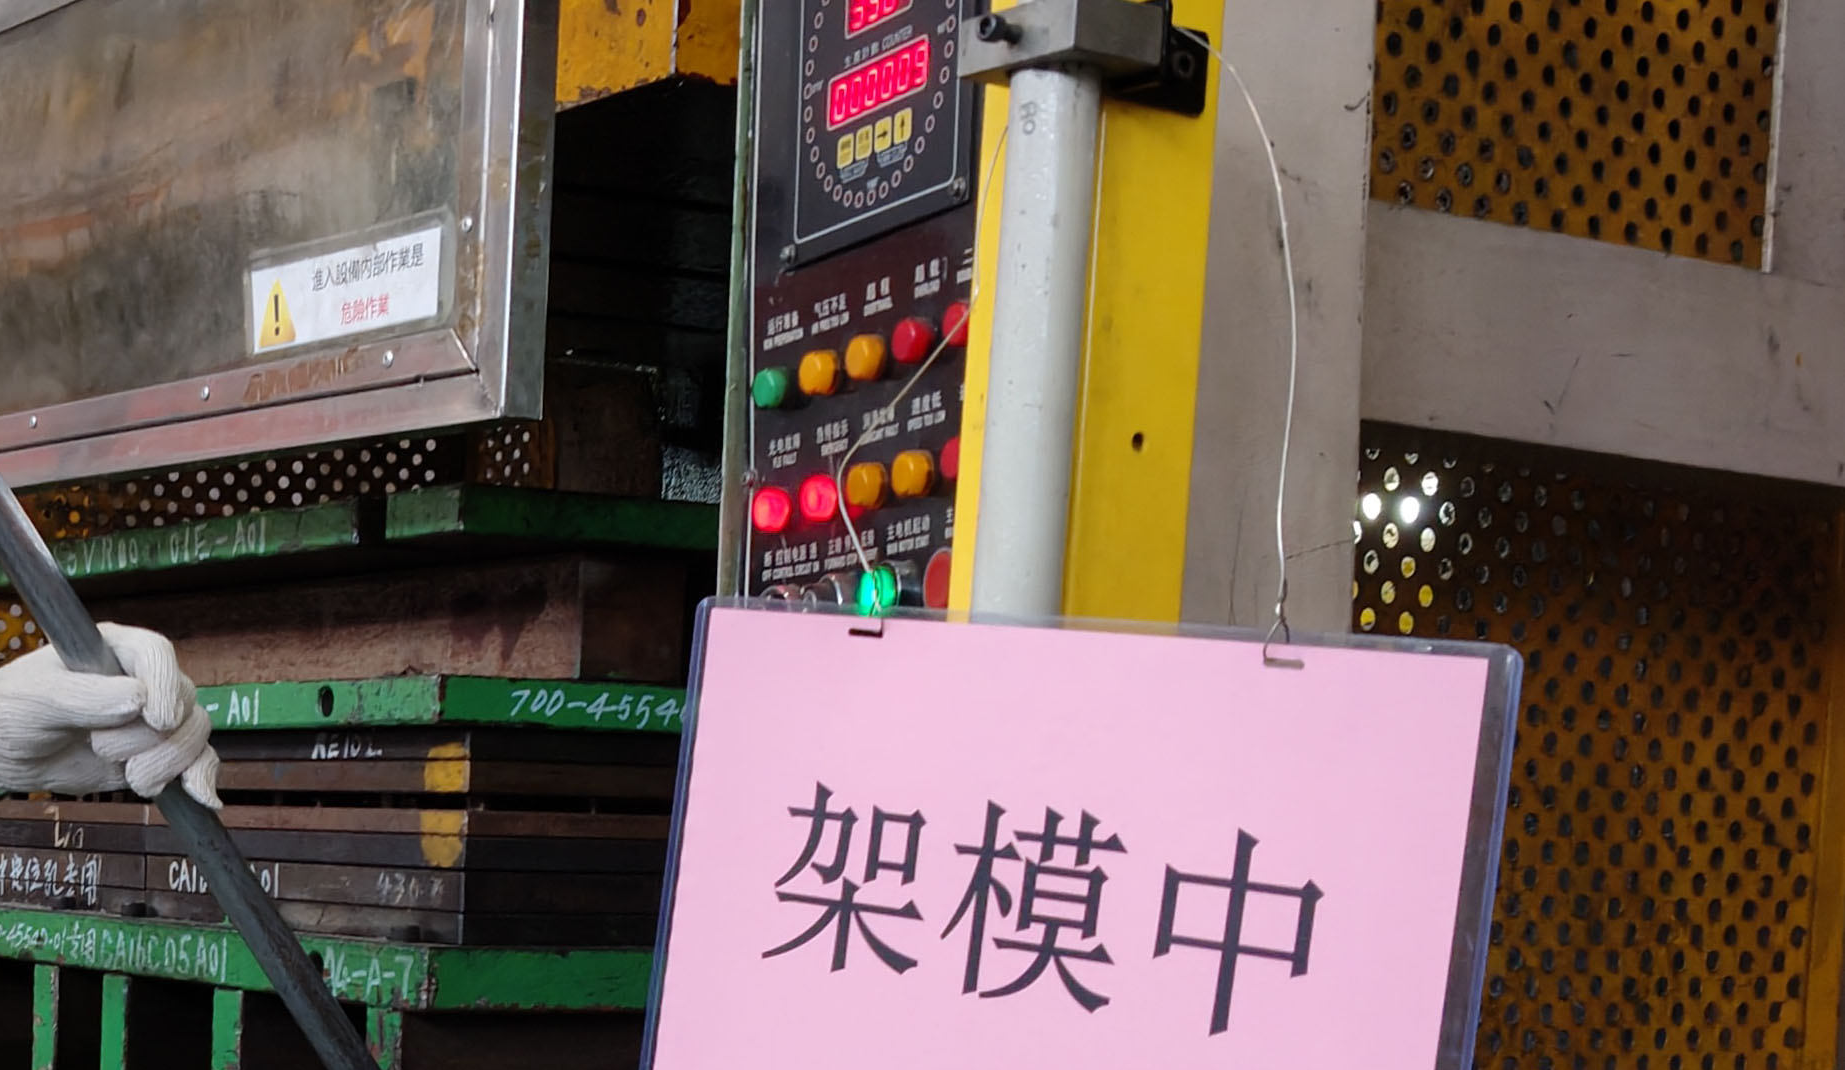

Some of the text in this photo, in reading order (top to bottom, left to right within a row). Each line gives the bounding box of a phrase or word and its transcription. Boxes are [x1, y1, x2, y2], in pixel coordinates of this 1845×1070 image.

[511, 689, 684, 730] 700-4554
[761, 780, 1325, 1037] 架模中
